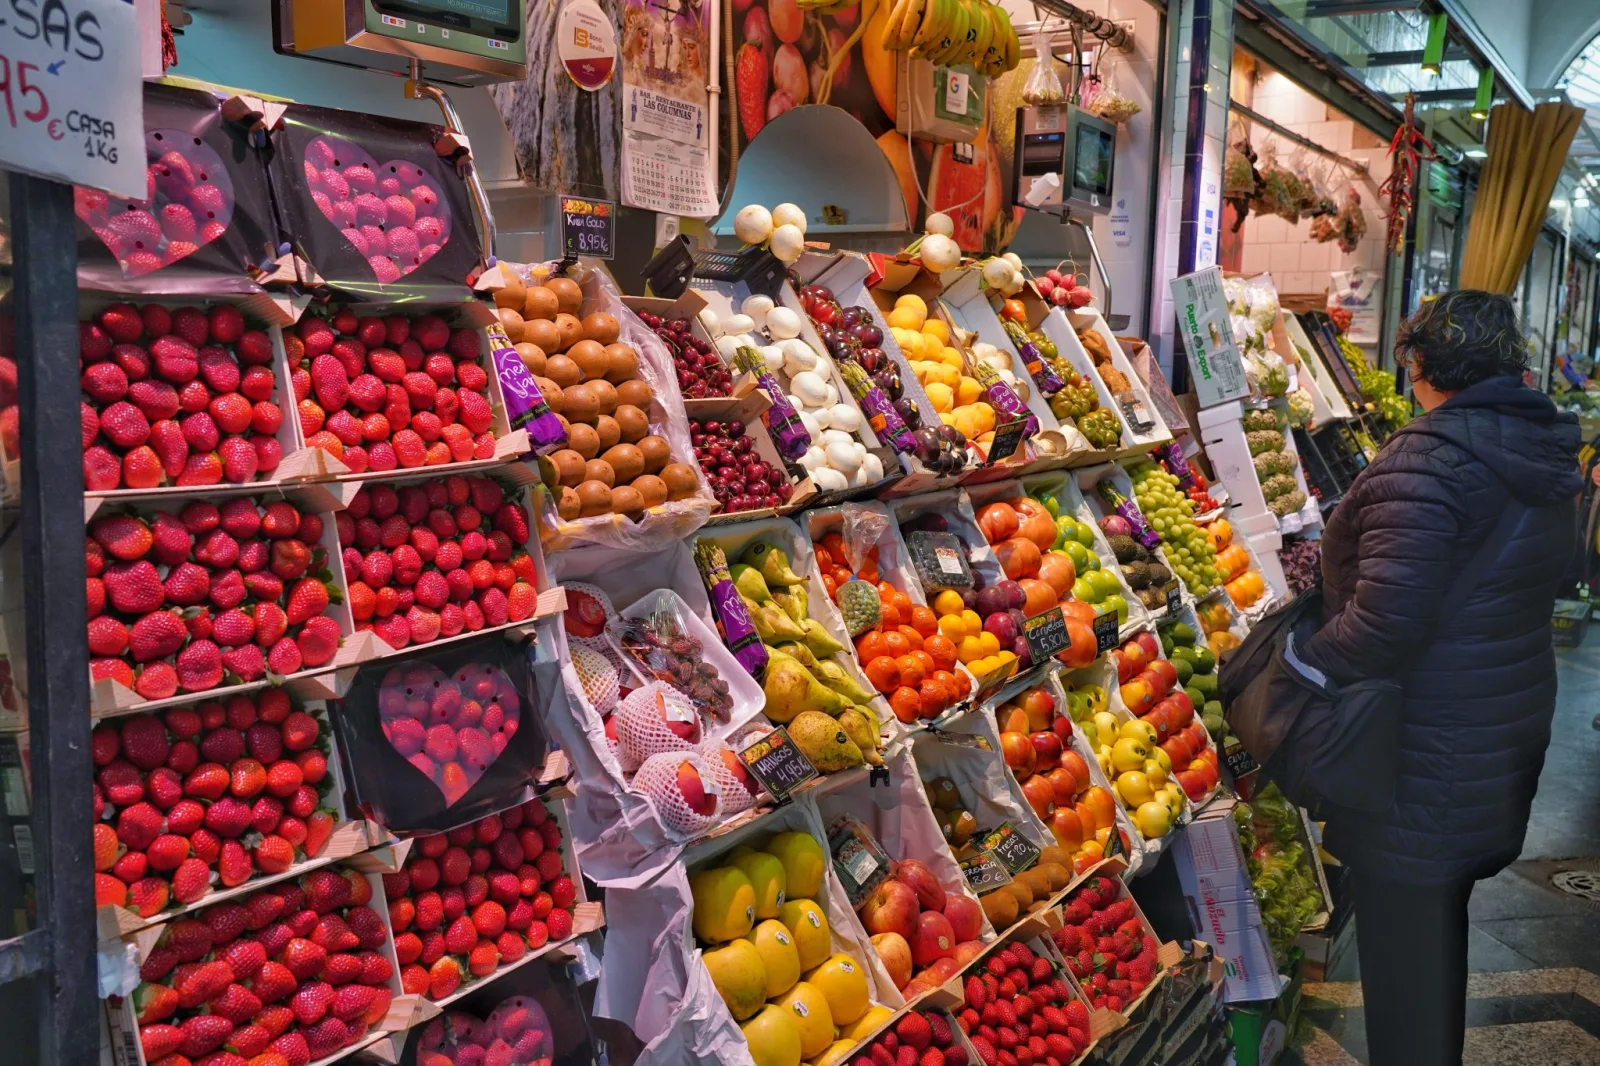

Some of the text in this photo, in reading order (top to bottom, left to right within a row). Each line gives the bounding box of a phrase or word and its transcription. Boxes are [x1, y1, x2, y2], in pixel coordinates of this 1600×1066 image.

[0, 0, 104, 61] SAS
[589, 33, 603, 43] Bono
[589, 42, 605, 53] Sevilla
[640, 90, 651, 99] BAR
[655, 95, 697, 113] RESTAURANTE
[643, 99, 692, 120] LAS COLUMNAS
[47, 118, 65, 141] €
[66, 110, 115, 140] CAJA
[1186, 303, 1199, 334] Puerto
[1197, 349, 1212, 380] Export
[756, 745, 793, 776] MANGOS
[963, 860, 997, 877] ERENCIA
[994, 871, 1005, 882] €
[1205, 896, 1225, 945] Mozuelo
